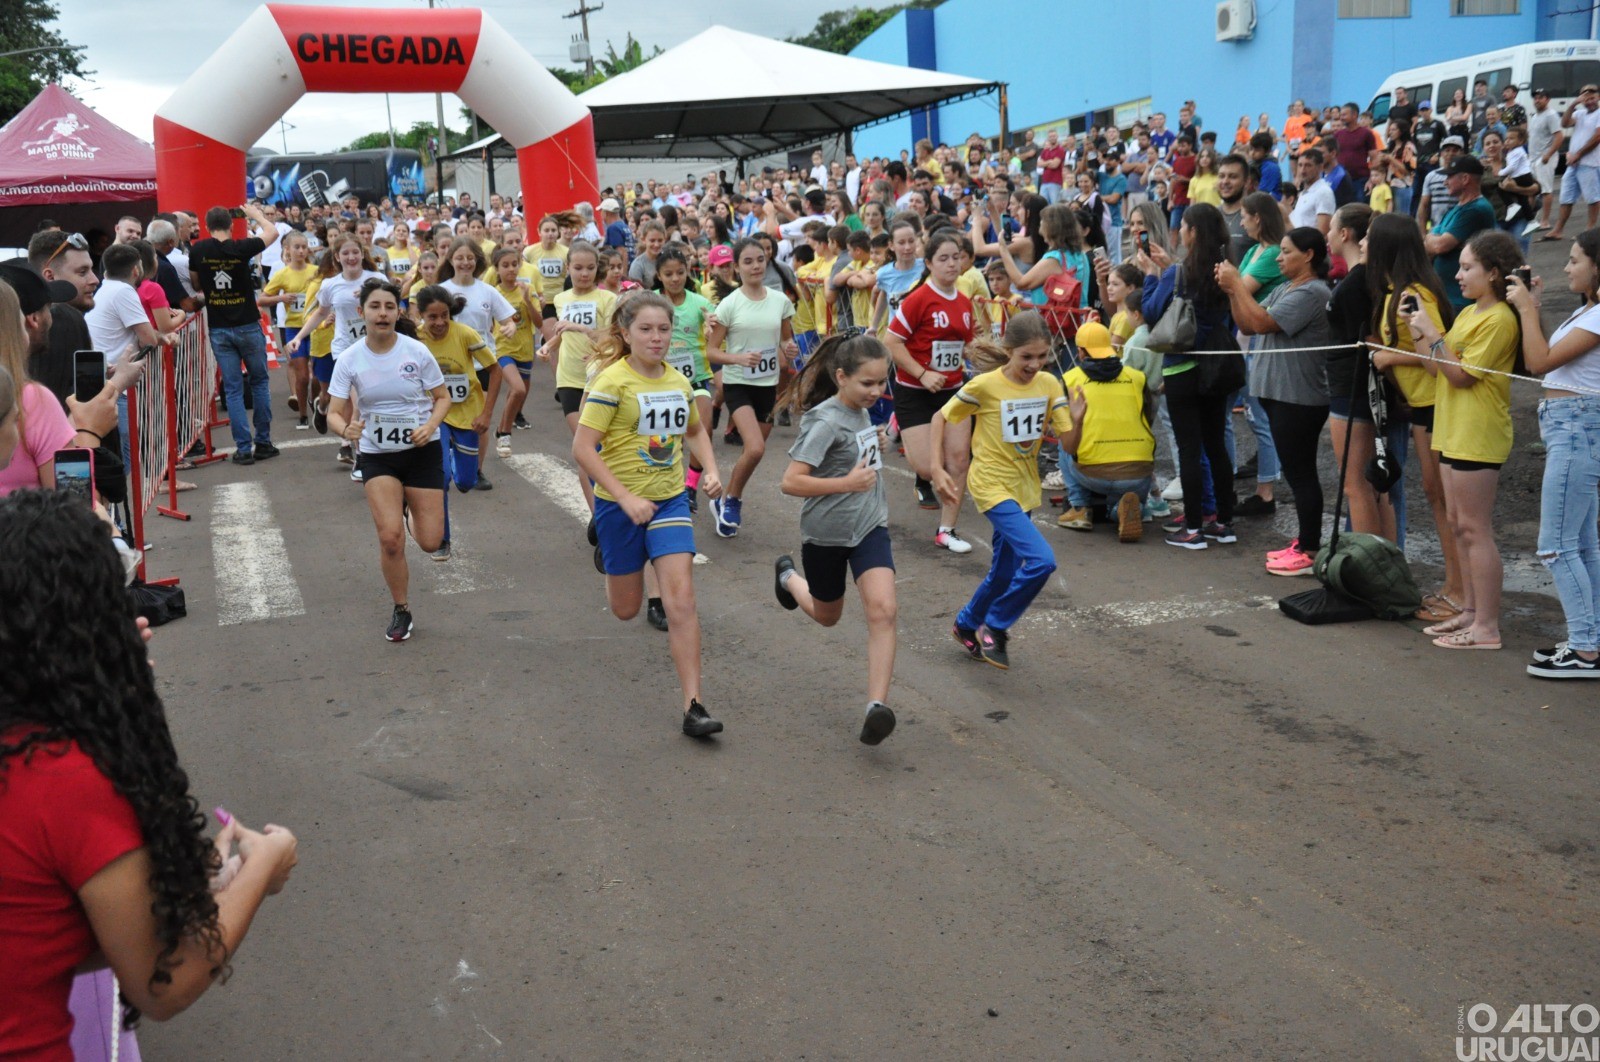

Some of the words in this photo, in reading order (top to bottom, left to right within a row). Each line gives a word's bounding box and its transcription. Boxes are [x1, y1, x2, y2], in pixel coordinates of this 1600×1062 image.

[297, 33, 465, 65] CHEGADA
[28, 143, 84, 156] MARATONA
[46, 151, 58, 159] DO
[62, 149, 95, 159] VINHO
[540, 264, 561, 275] 103
[294, 301, 305, 309] 14
[564, 312, 593, 325] 105
[931, 311, 950, 328] 10
[349, 324, 367, 338] 14
[935, 352, 960, 368] 136
[645, 407, 686, 429] 116
[1007, 413, 1045, 436] 115
[373, 427, 414, 444] 148
